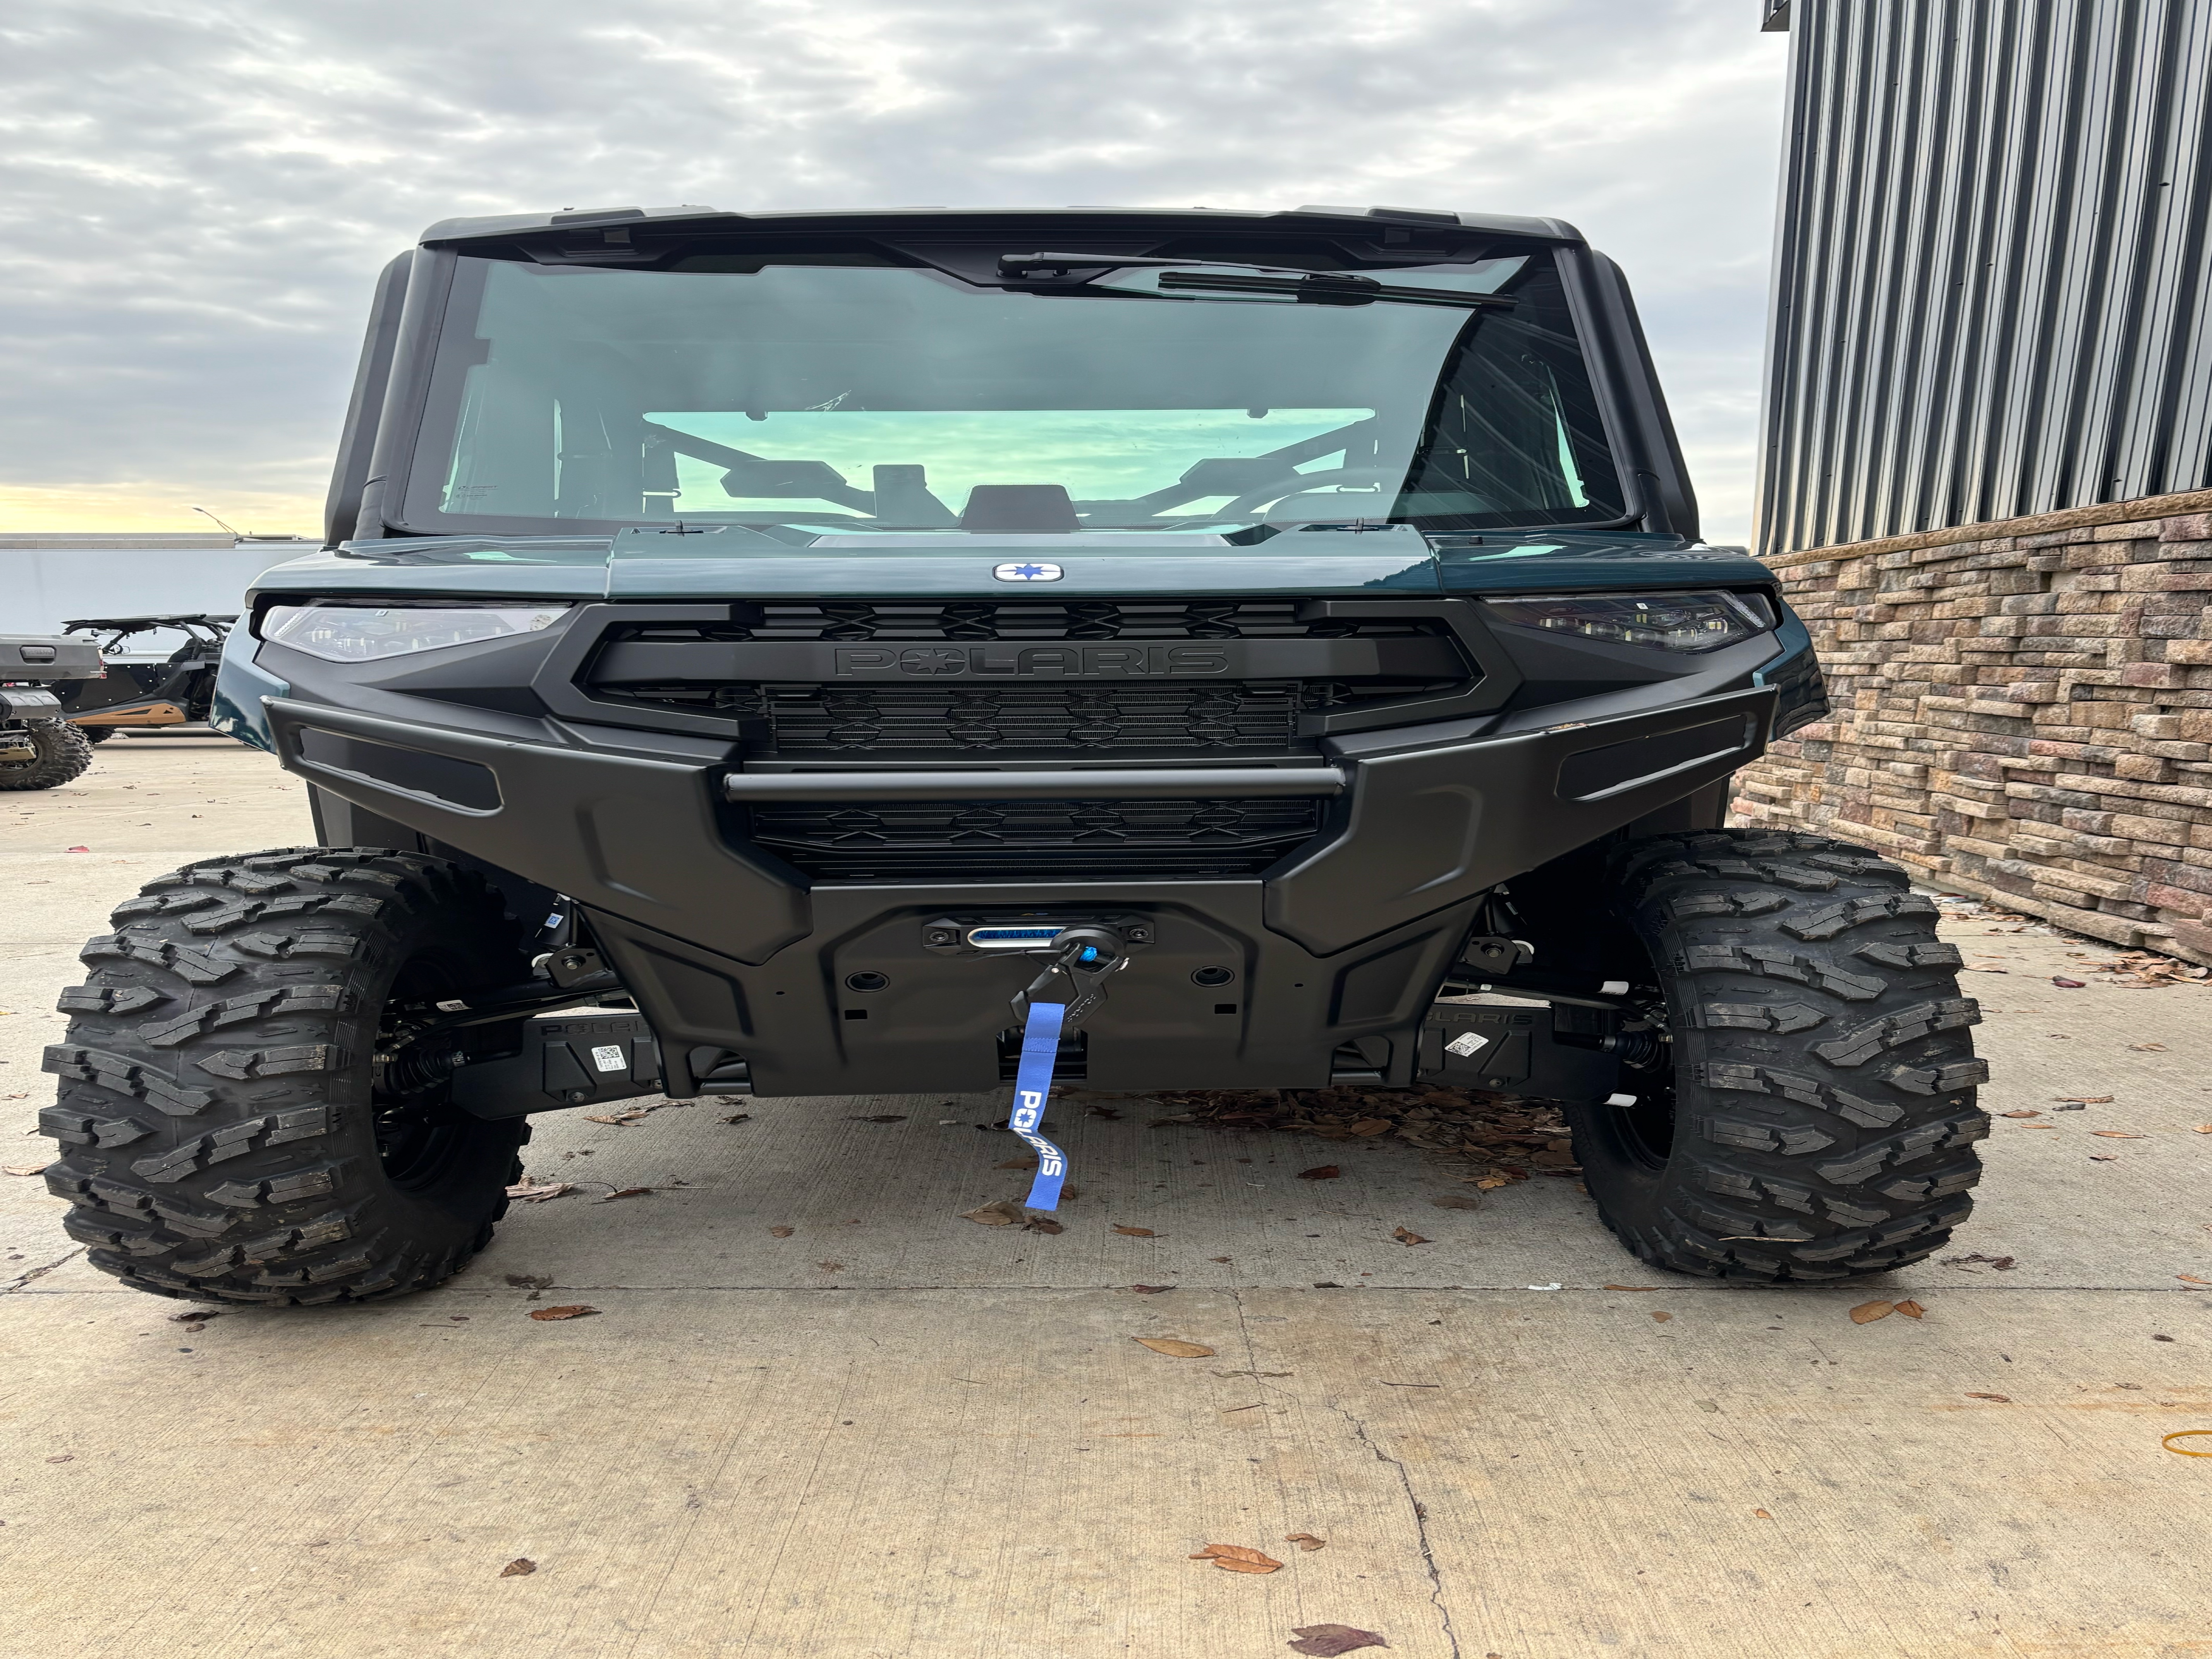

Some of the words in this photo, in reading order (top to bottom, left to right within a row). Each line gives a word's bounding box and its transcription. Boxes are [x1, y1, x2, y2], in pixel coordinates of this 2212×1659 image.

[835, 646, 1228, 675] POLARIS
[541, 1020, 649, 1036] POLAR
[1013, 1091, 1062, 1176] POLARIS
